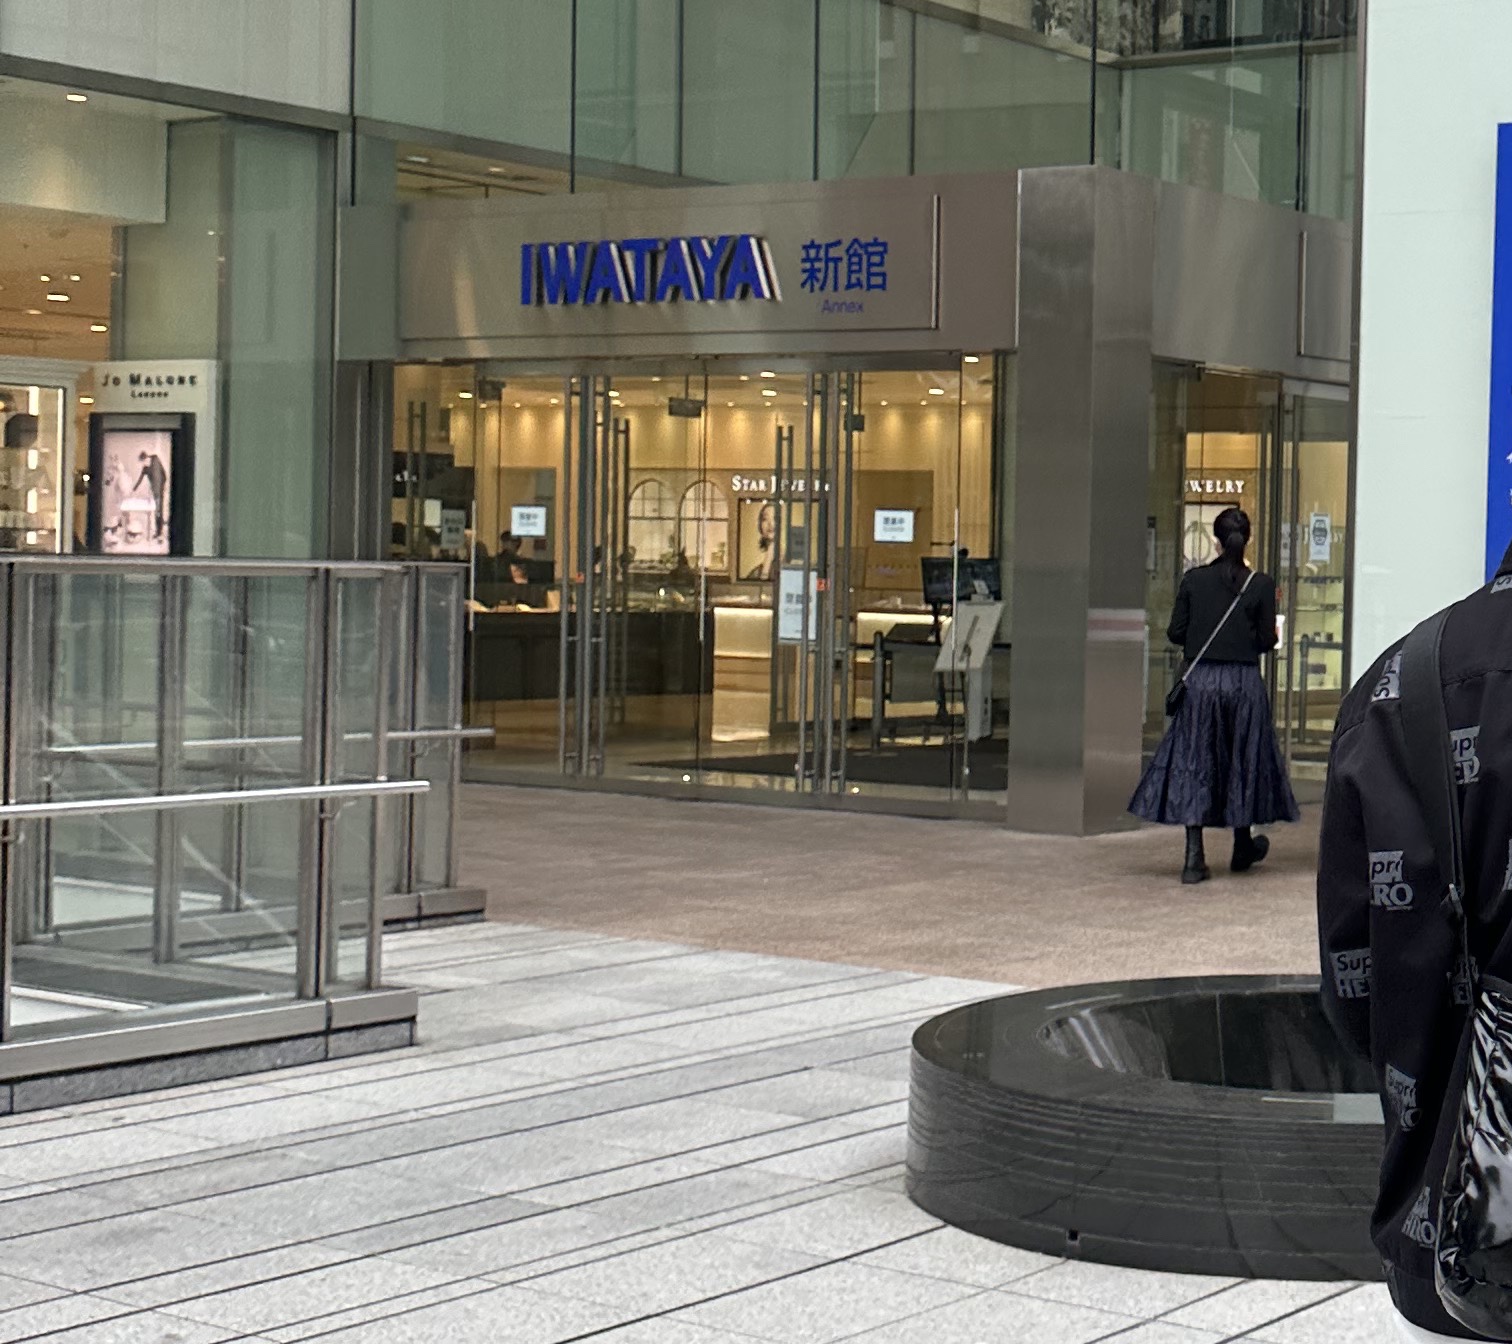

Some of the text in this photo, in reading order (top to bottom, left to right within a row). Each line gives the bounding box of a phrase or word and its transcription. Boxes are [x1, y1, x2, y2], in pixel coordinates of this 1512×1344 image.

[521, 233, 775, 306] IWATAYA
[800, 237, 889, 294] 新館
[731, 475, 767, 492] STAR
